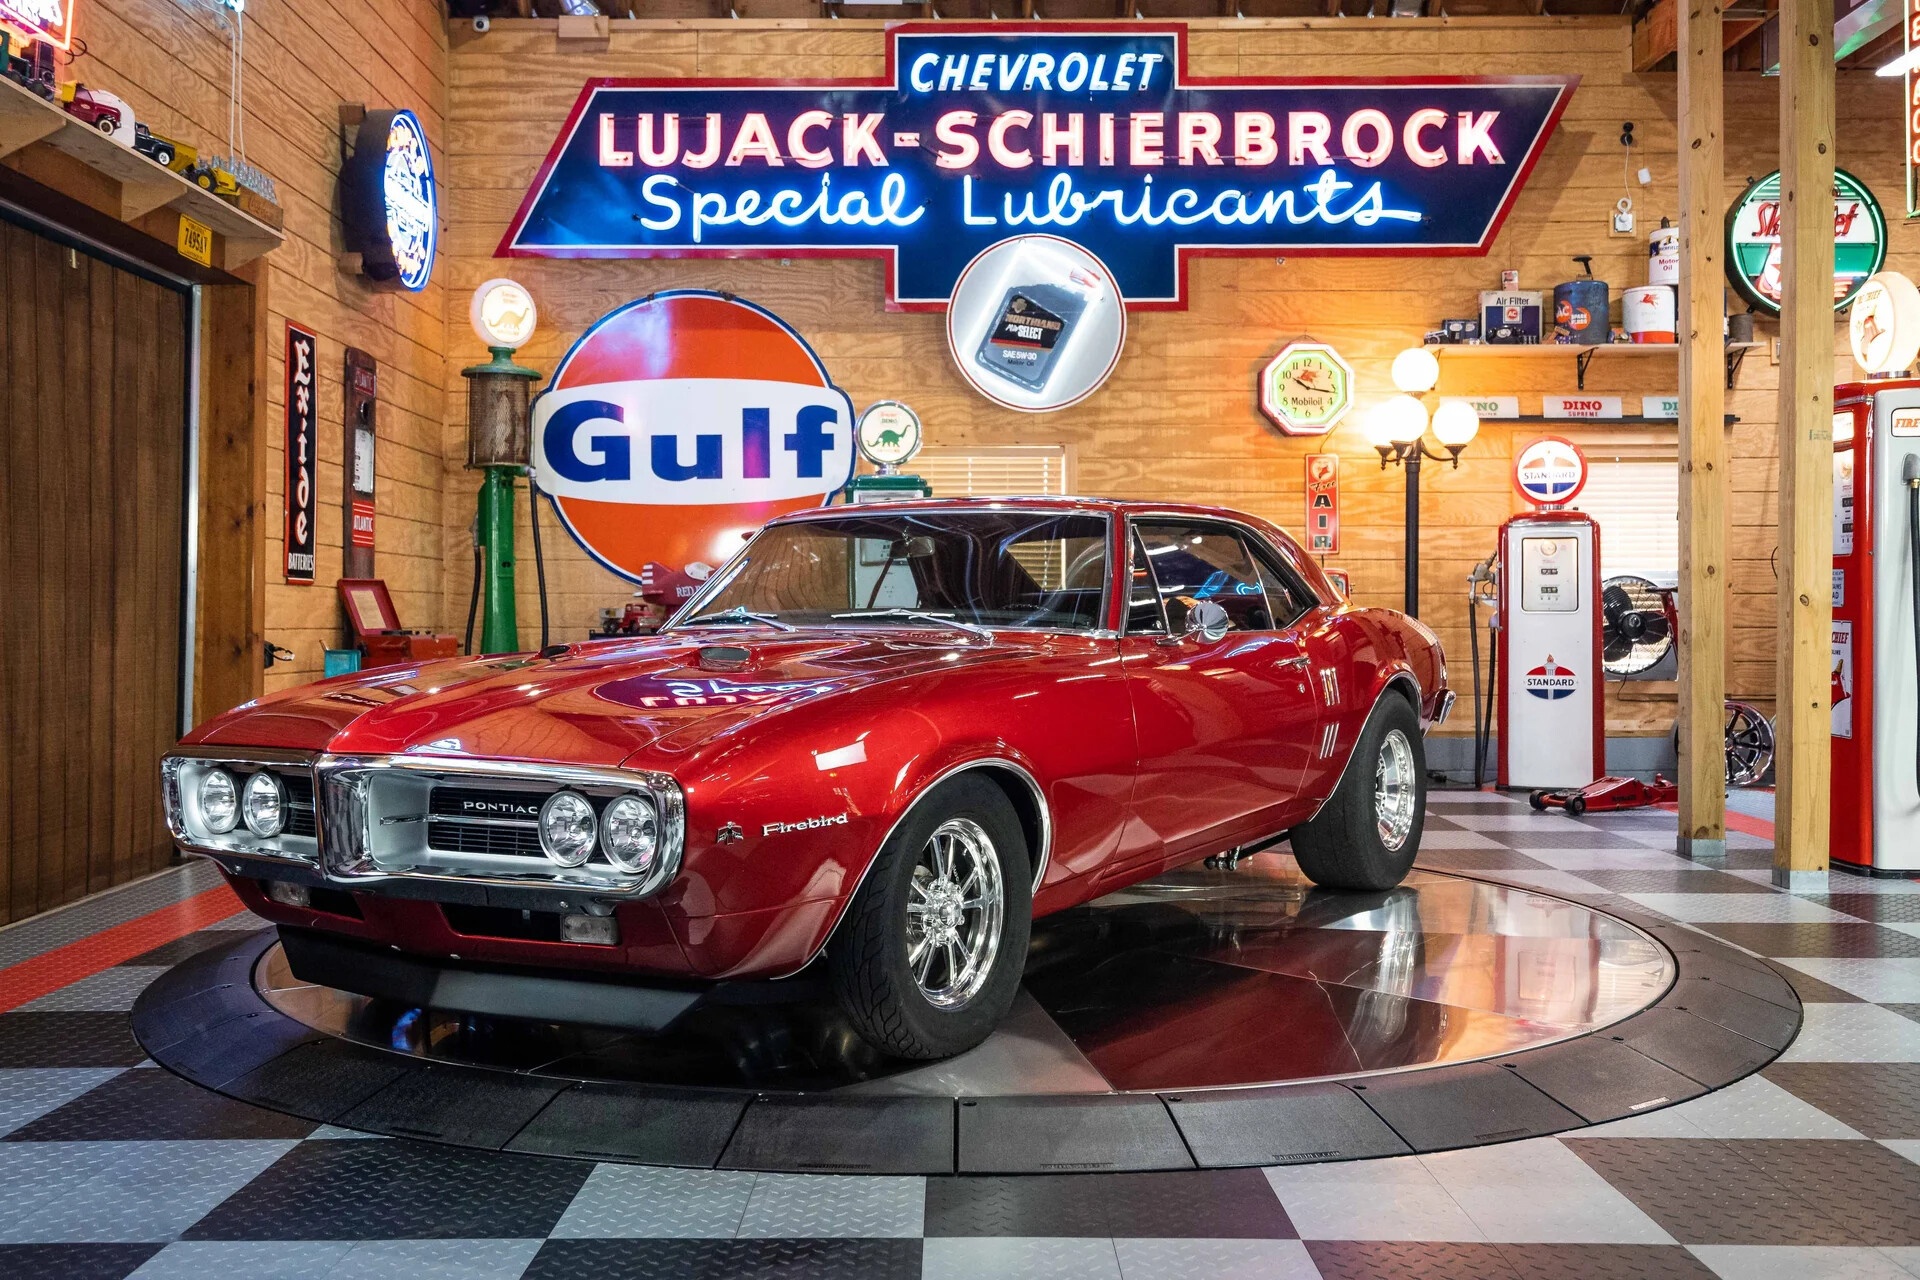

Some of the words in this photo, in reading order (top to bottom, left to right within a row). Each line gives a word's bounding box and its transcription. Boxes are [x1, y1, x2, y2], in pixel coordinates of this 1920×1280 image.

[909, 52, 1163, 93] CHEVROLET
[597, 108, 1506, 169] LUJACK-SCHIERBROCK
[639, 172, 925, 243] Special
[962, 168, 1424, 228] Lubricants
[1495, 297, 1508, 306] Air
[1509, 297, 1530, 306] Filter
[1507, 309, 1518, 317] AC
[1556, 304, 1570, 317] AC
[1018, 324, 1043, 340] SELECT
[1002, 349, 1016, 359] SAE
[1292, 362, 1299, 370] 11
[1303, 358, 1312, 367] 12
[1282, 371, 1292, 379] 10
[1327, 370, 1333, 379] 2
[1279, 384, 1286, 393] 9
[1291, 396, 1323, 406] Mobiloil
[1562, 400, 1603, 411] DINO
[1304, 409, 1311, 418] 6
[542, 399, 839, 484] Gulf
[1523, 471, 1576, 480] STANARD
[353, 514, 374, 533] ATLANTIC
[287, 552, 314, 572] BATTERIES
[1526, 677, 1575, 687] STANDARD
[463, 800, 539, 815] PONTIAC
[761, 811, 849, 837] Firebird
